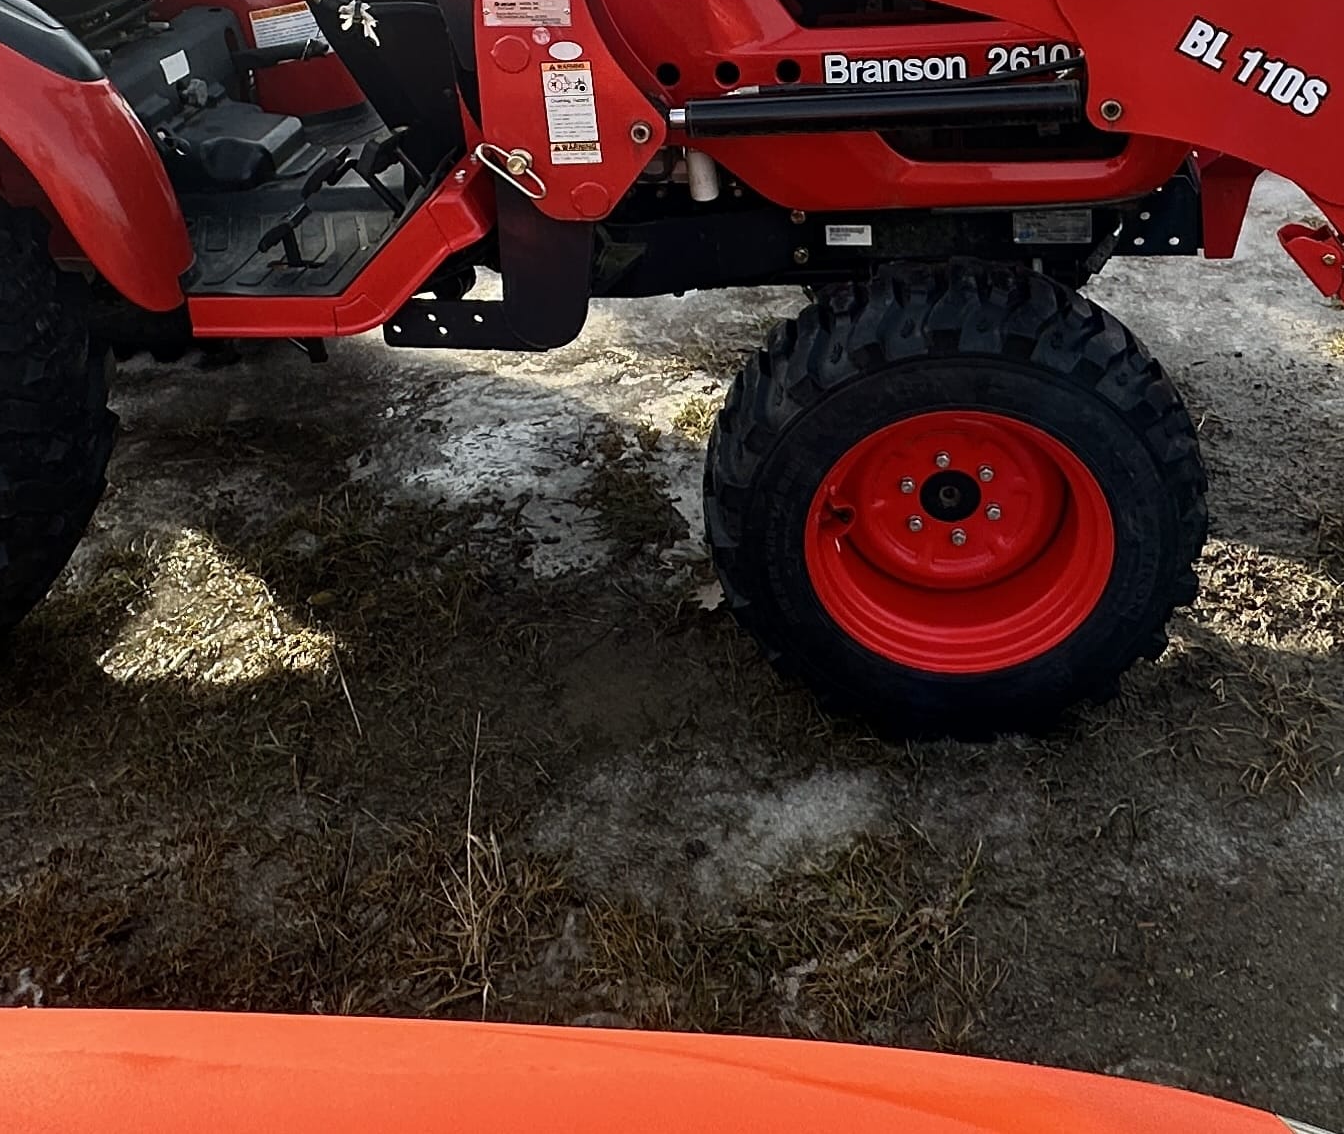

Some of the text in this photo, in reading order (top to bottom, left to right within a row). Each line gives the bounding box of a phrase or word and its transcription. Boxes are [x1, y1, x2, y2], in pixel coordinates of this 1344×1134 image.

[822, 53, 967, 85] Branson
[1177, 17, 1329, 116] BL 110S
